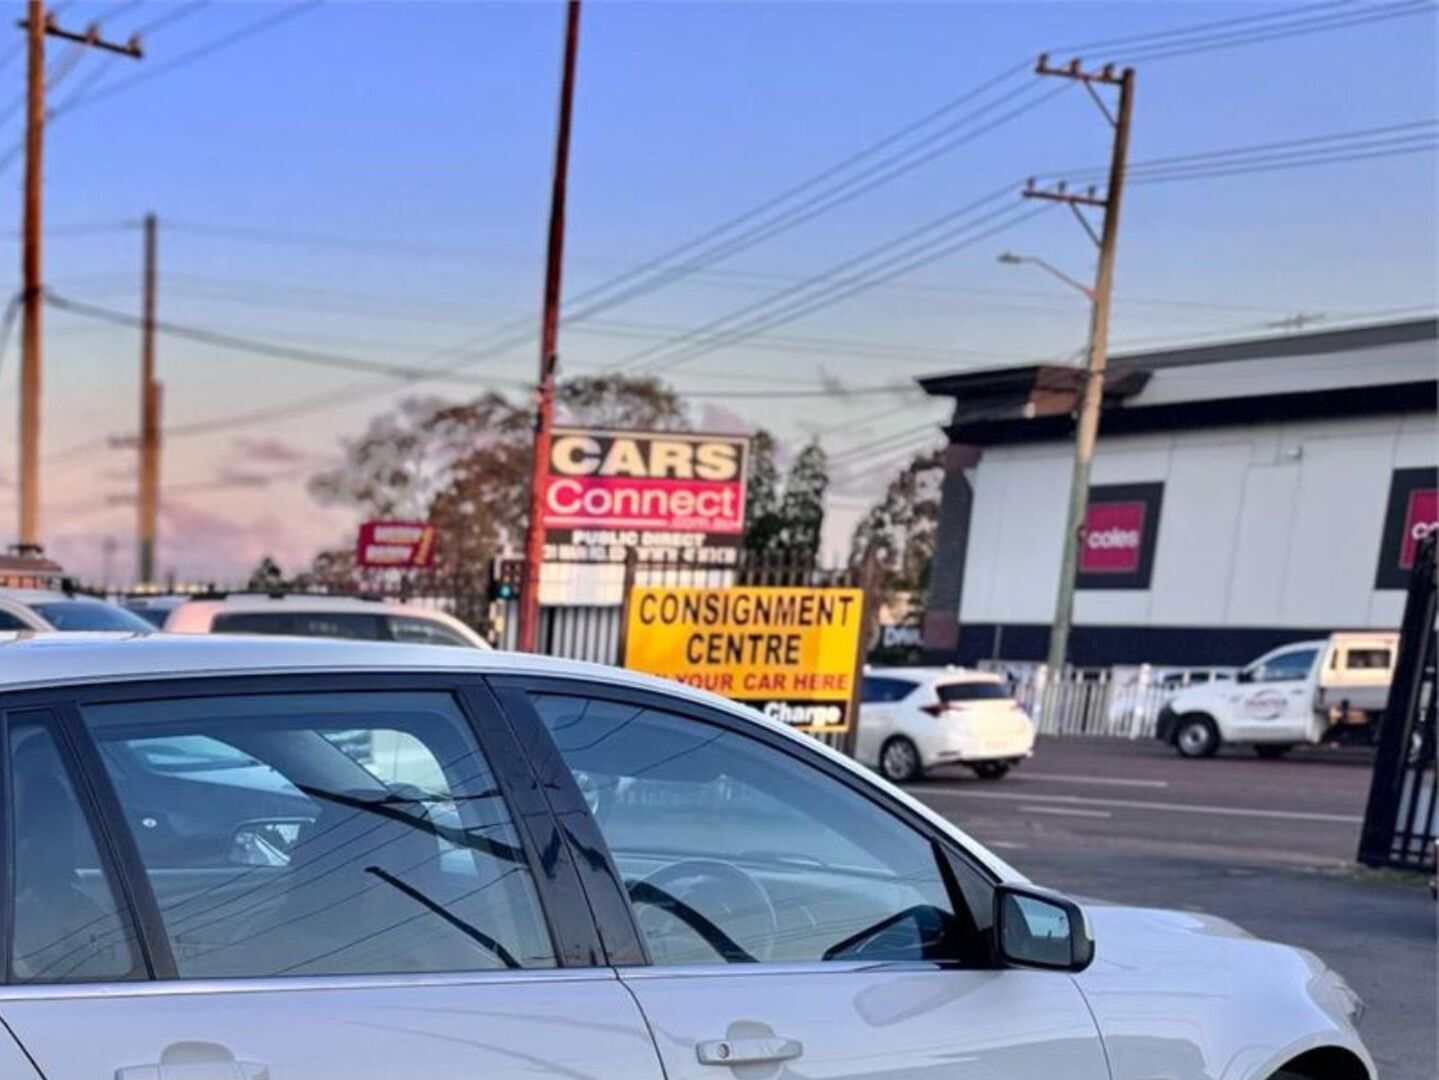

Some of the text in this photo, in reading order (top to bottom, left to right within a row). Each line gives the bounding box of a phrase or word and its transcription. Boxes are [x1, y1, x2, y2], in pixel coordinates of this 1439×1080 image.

[551, 436, 738, 480] CARS
[547, 479, 735, 517] Connect
[572, 530, 707, 547] PUBLIC DIRECT
[1088, 527, 1140, 549] coles
[639, 593, 854, 627] CONSIGNMENT
[686, 633, 802, 665] CENTRE
[743, 673, 785, 690] CAR
[793, 674, 849, 691] HERE
[763, 701, 842, 727] Charge
